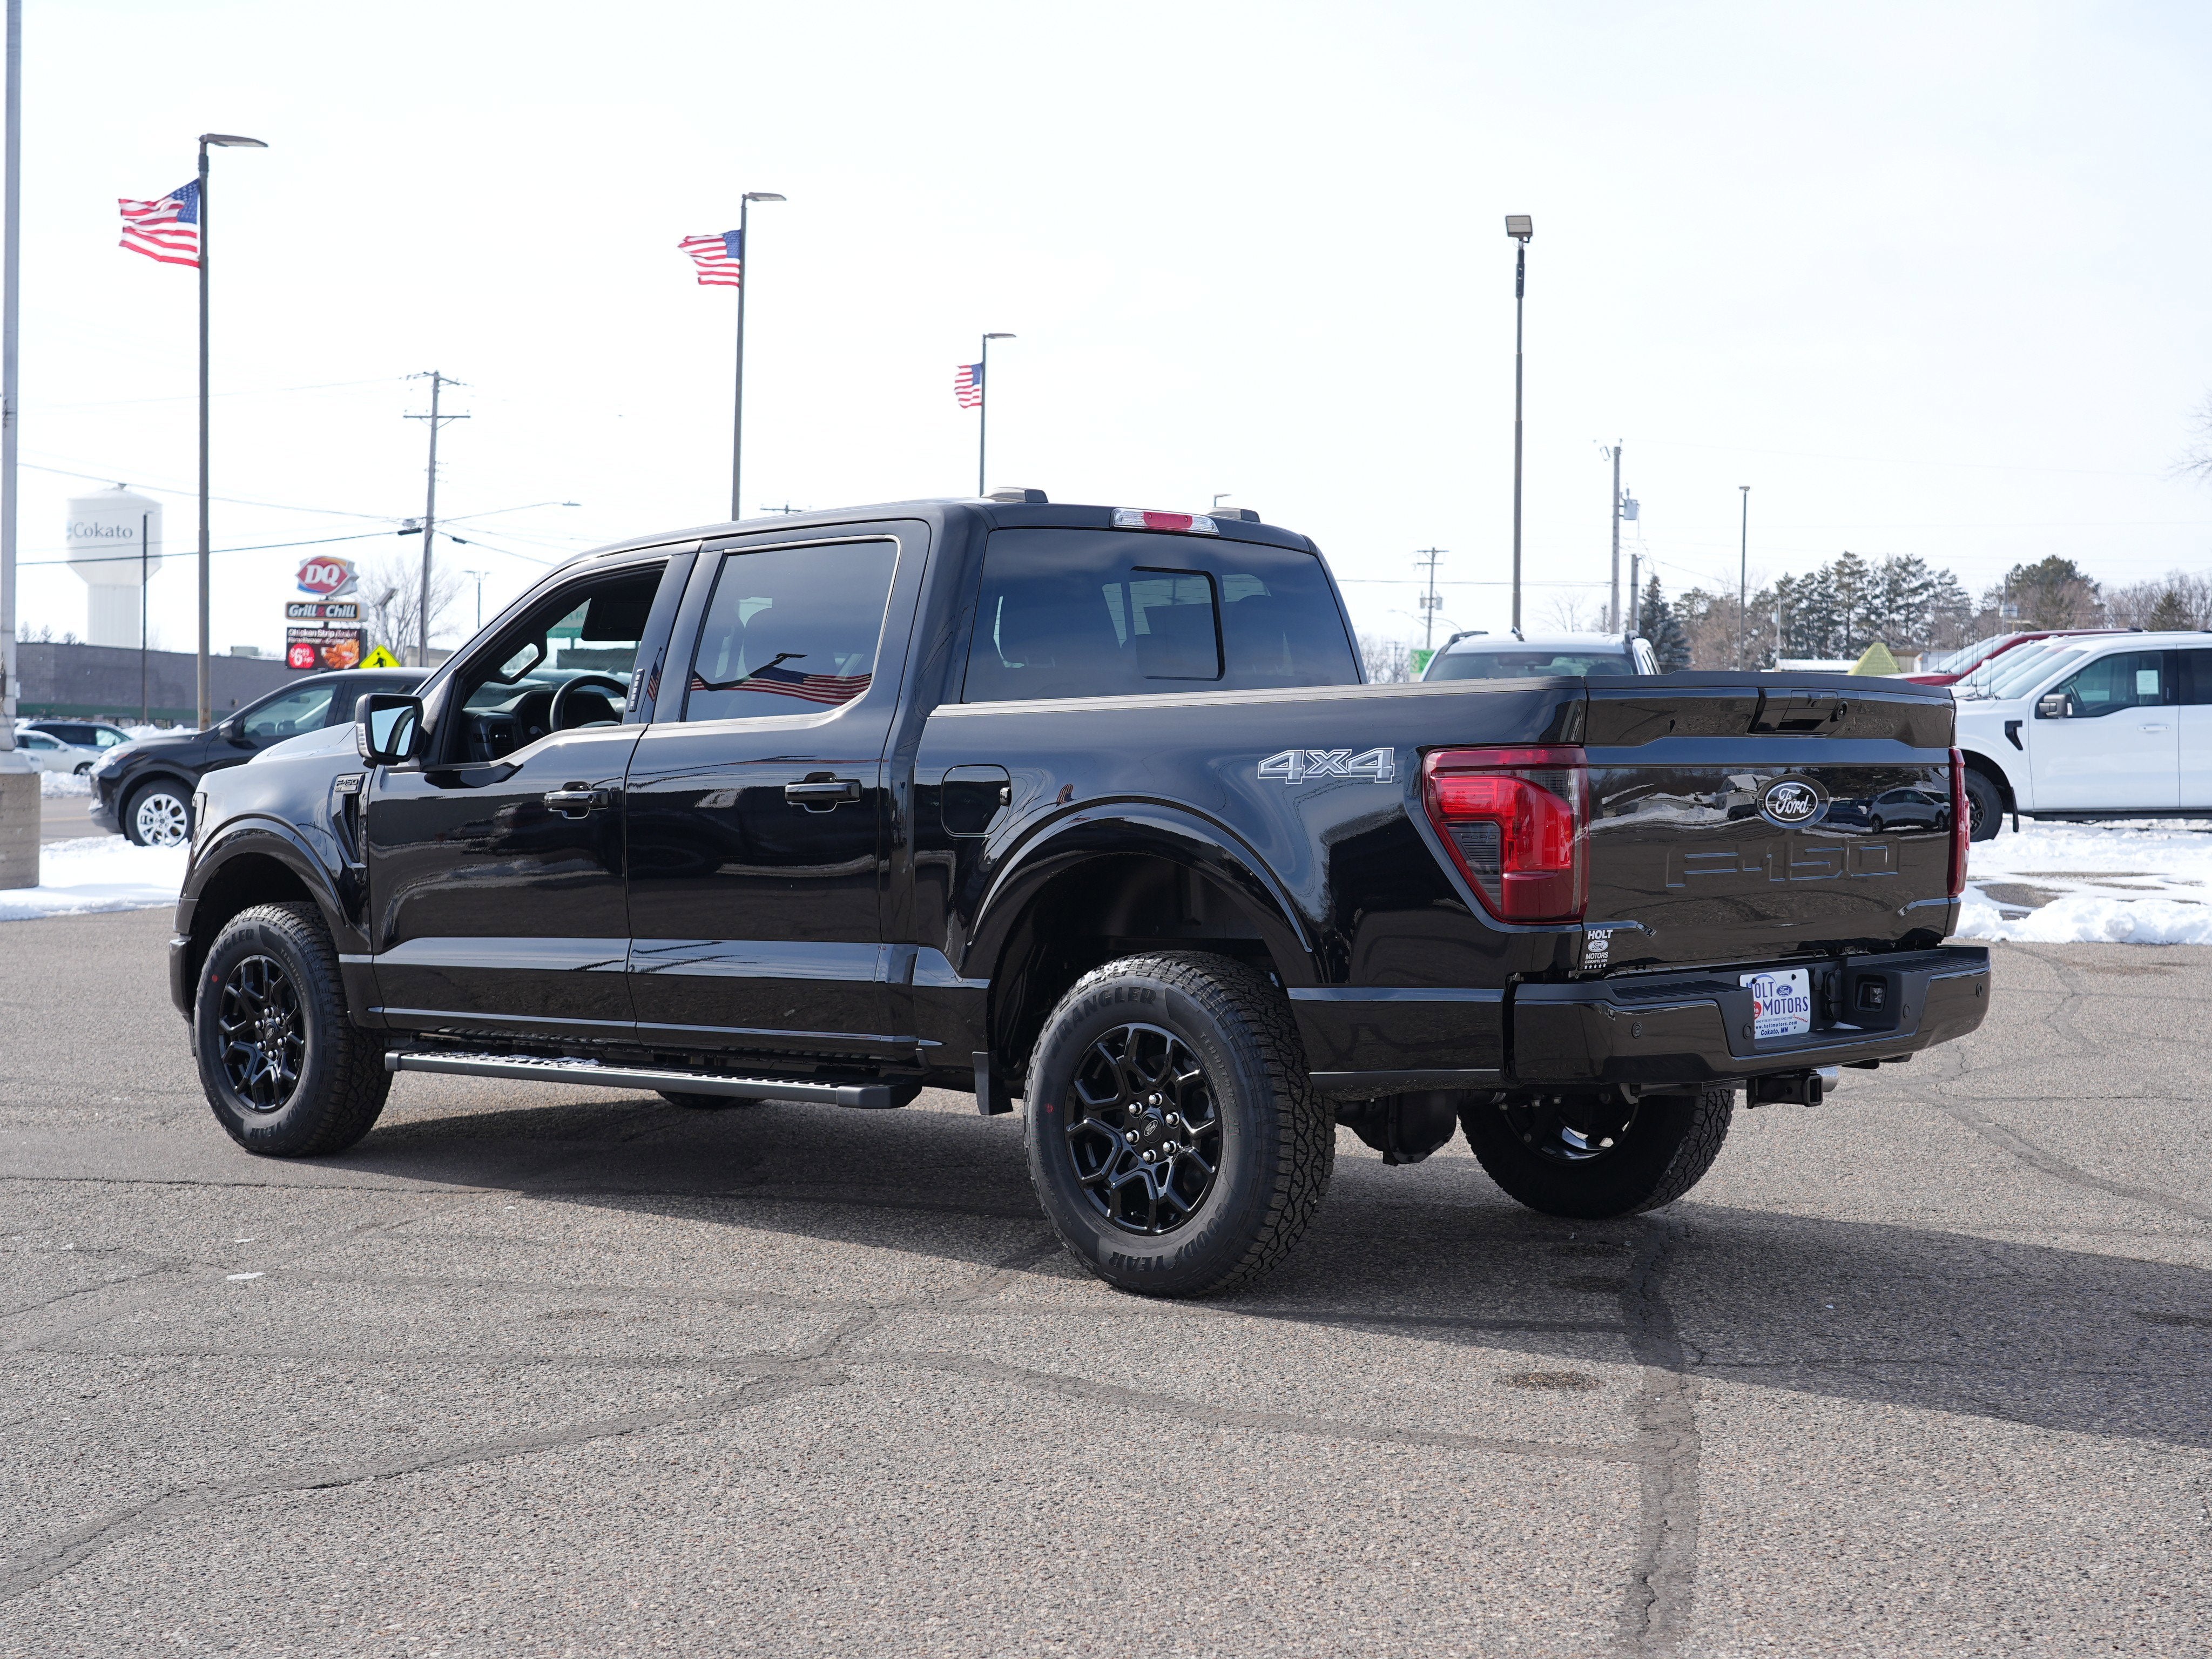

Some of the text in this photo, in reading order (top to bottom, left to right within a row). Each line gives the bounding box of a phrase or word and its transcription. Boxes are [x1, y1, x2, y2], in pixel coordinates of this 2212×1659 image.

[74, 522, 133, 539] Cokato
[304, 564, 340, 587] DQ
[288, 604, 317, 617] Grill
[325, 604, 356, 617] Chill
[1775, 787, 1810, 814] Ford
[1666, 835, 1901, 888] F-150
[1587, 929, 1613, 940] HOLT
[1585, 952, 1609, 960] MOTORS
[1763, 996, 1809, 1016] MOTORS
[1045, 986, 1157, 1059] WRANGLER
[1756, 1021, 1797, 1029] ww.holtmotors.com
[1199, 1031, 1237, 1107] TERRITORY
